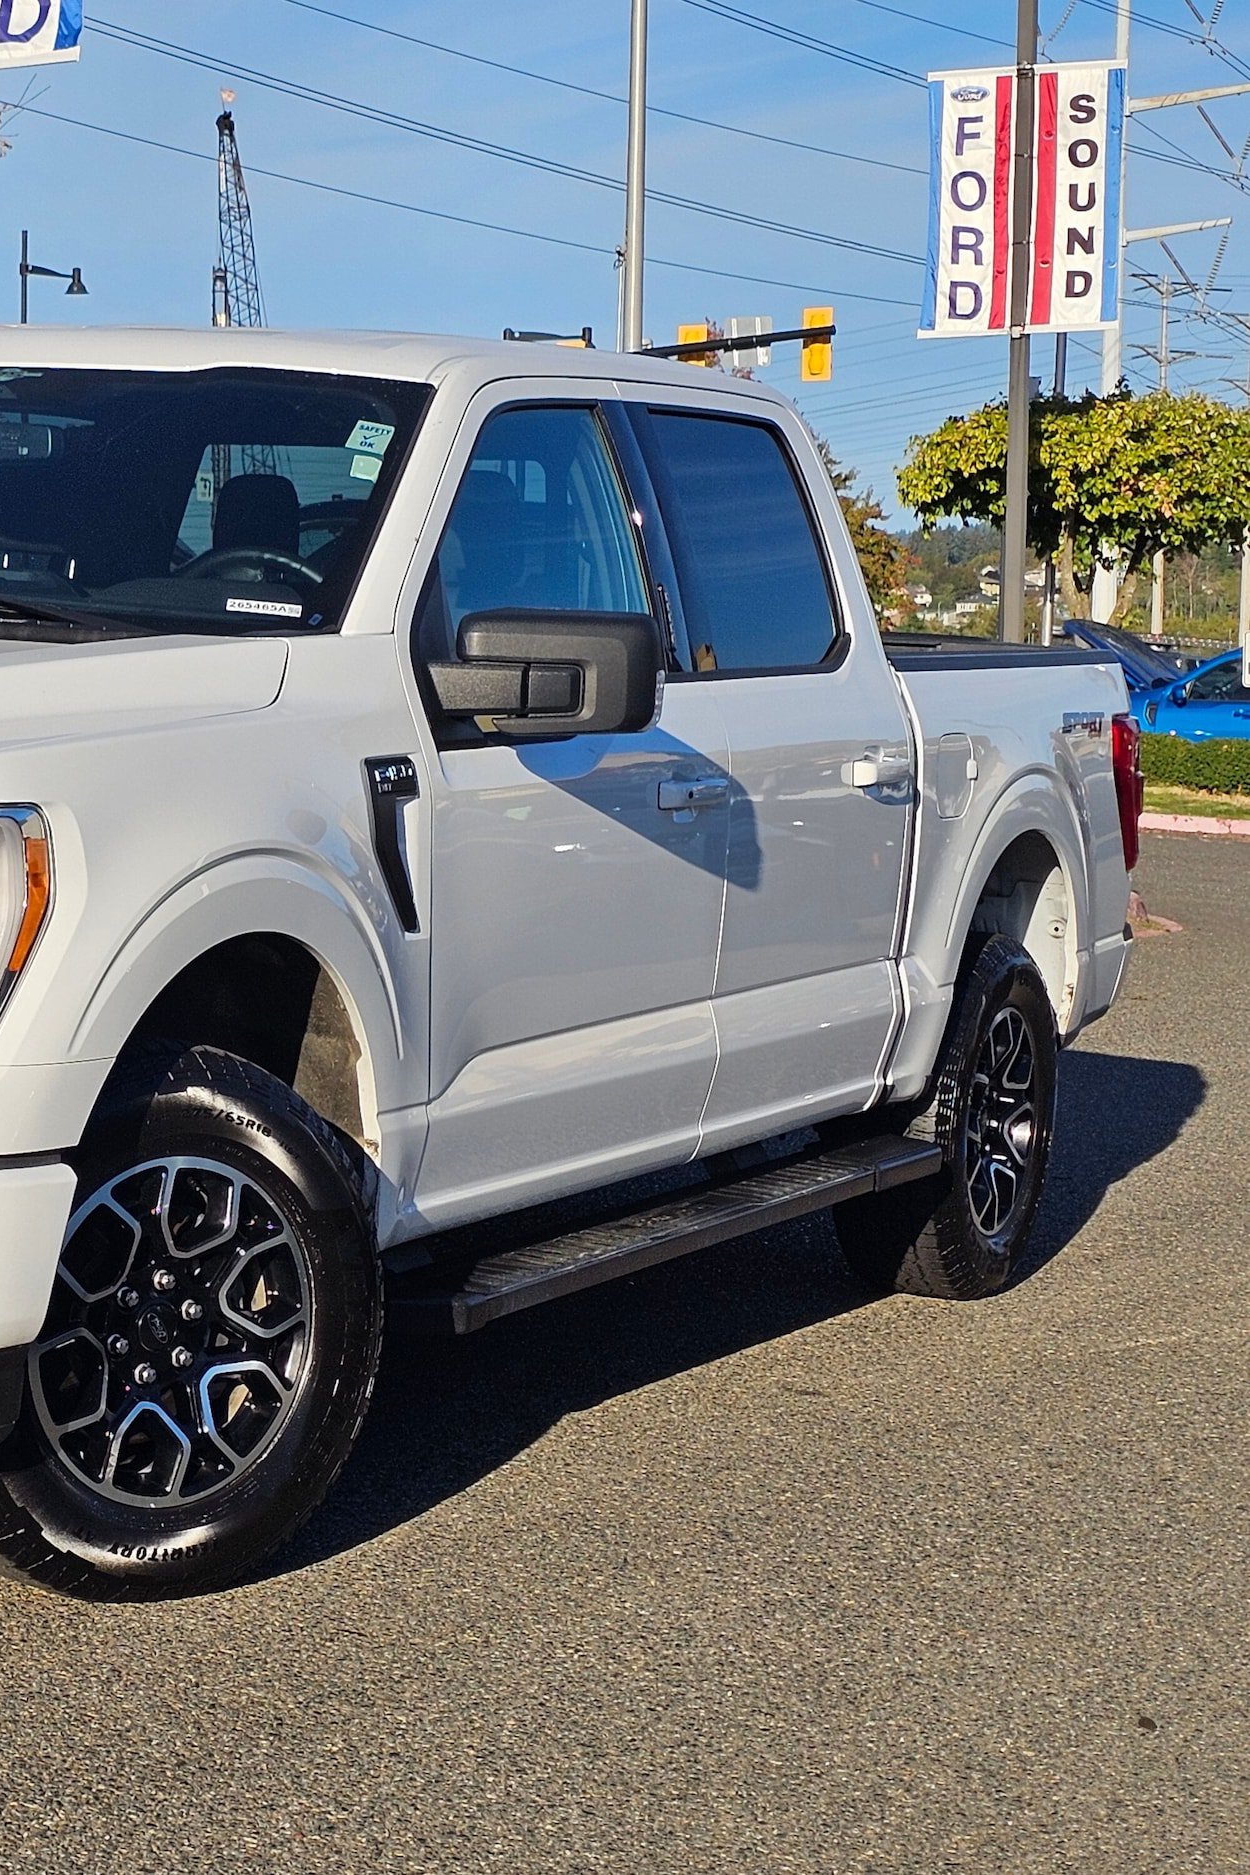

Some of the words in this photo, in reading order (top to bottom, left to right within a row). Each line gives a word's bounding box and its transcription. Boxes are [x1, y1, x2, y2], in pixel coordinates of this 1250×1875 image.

[1065, 94, 1098, 298] SOUND
[948, 115, 987, 321] FORD
[358, 424, 392, 435] SAFETY
[359, 440, 375, 449] OK
[229, 600, 287, 613] 265465A
